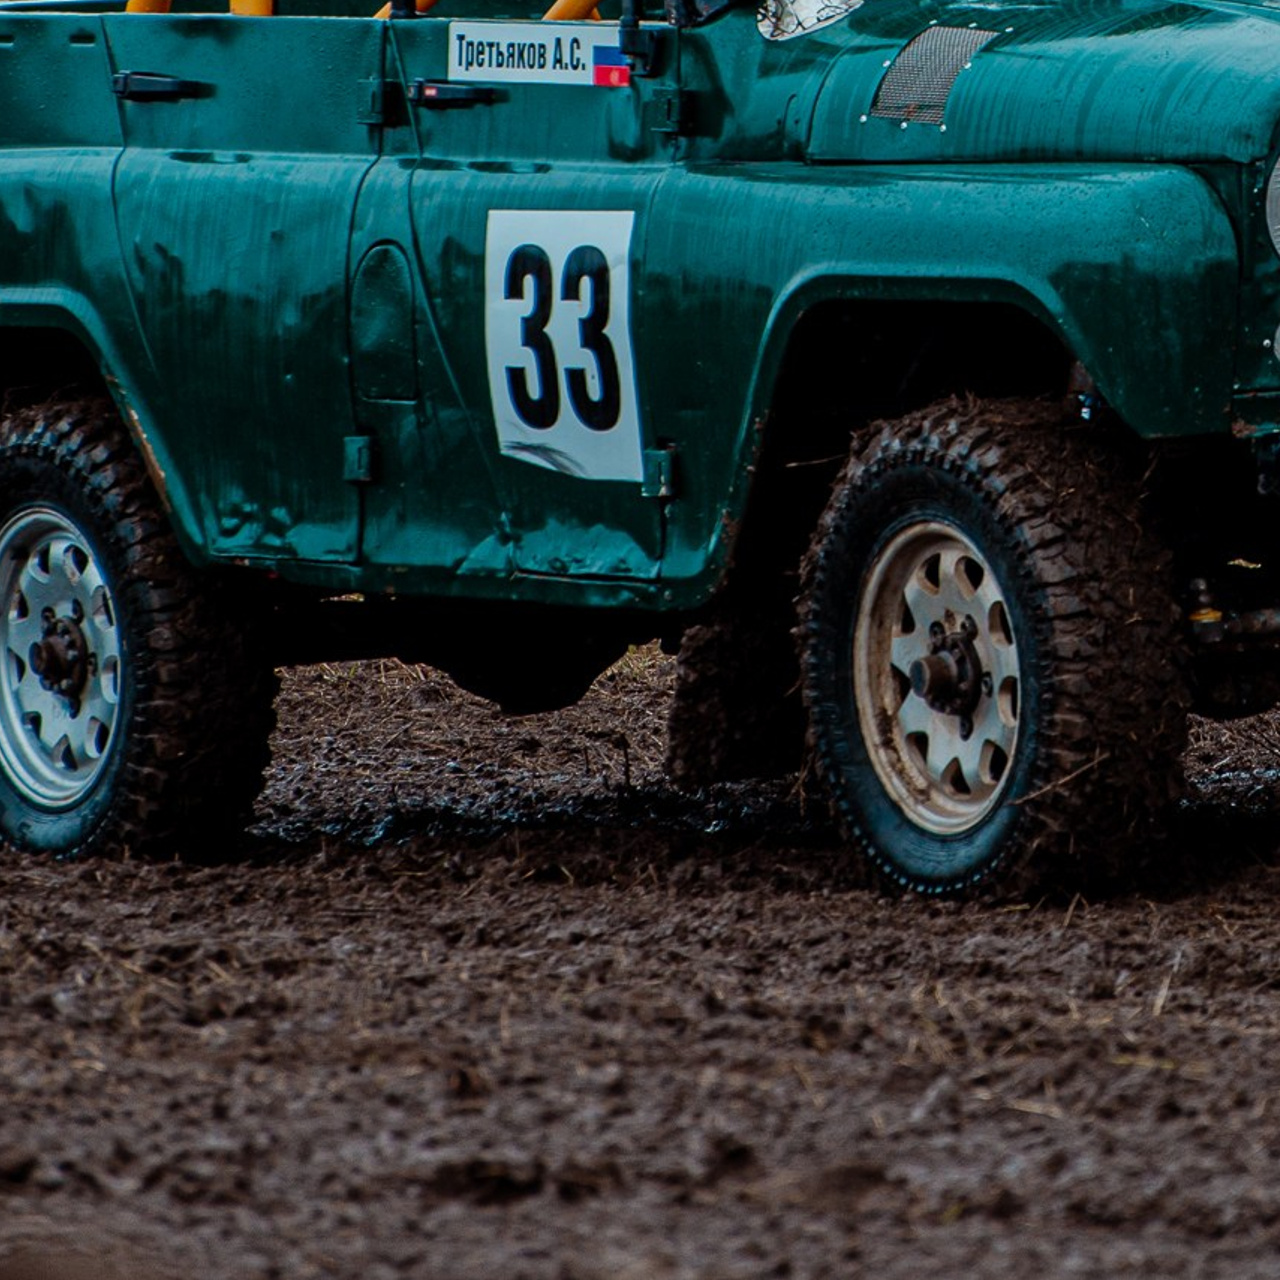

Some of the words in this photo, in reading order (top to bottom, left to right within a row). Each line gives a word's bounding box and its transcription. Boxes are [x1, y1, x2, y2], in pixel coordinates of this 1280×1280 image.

[456, 34, 547, 71] Третьяков
[552, 37, 586, 71] А.С.
[504, 243, 621, 432] 33
